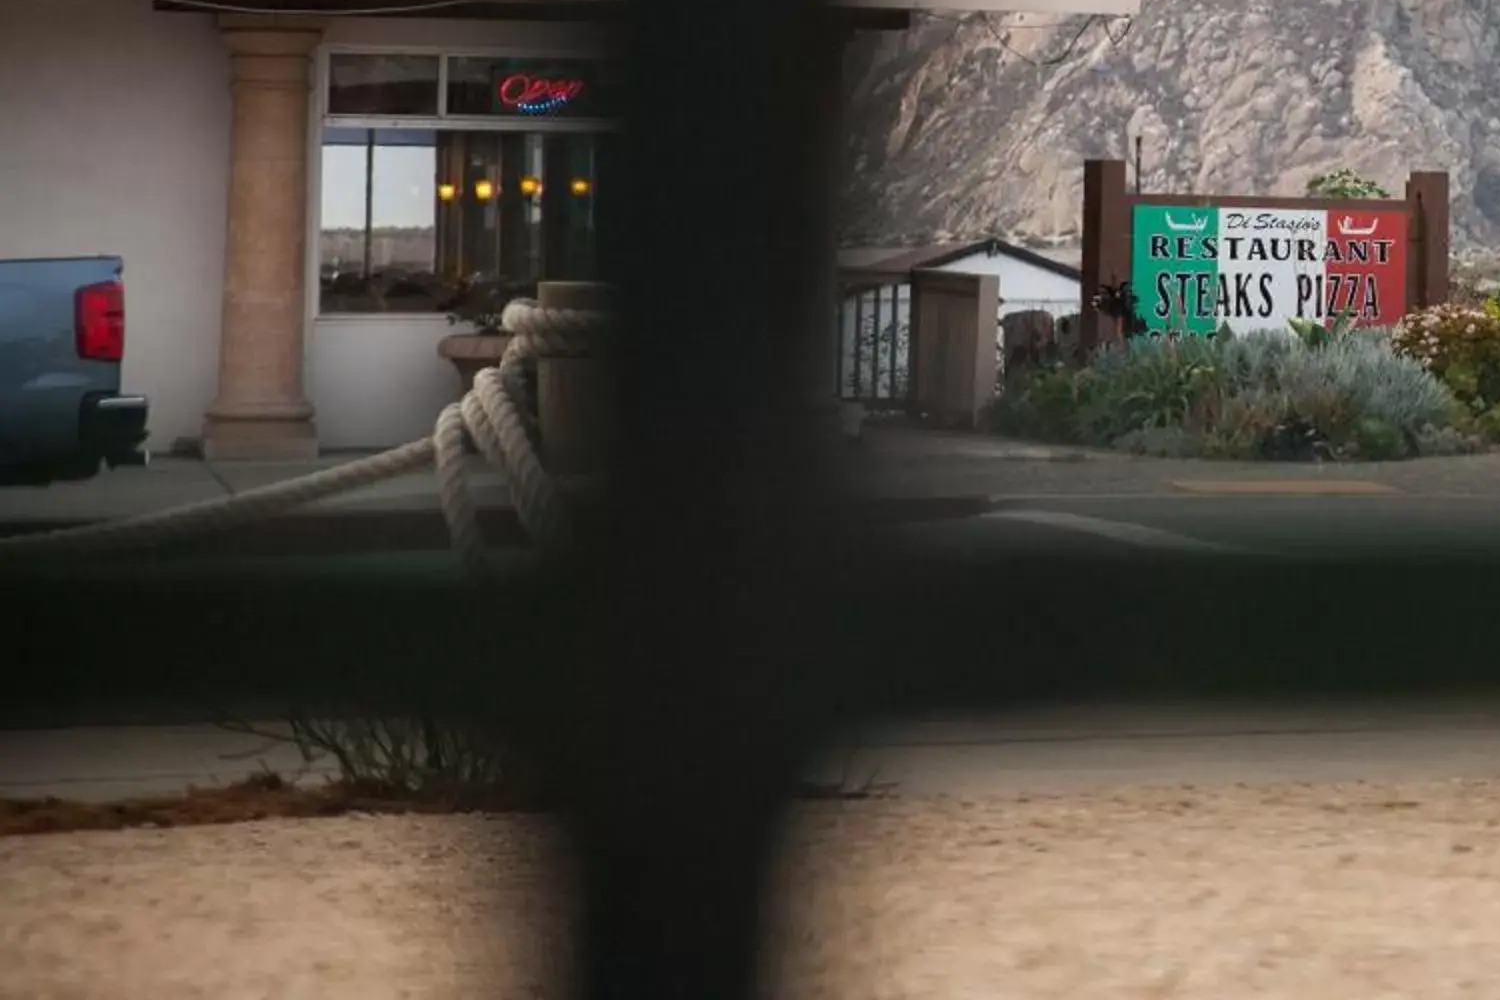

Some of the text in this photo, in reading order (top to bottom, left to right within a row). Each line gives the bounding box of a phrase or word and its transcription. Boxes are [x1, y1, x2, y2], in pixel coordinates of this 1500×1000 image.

[501, 74, 584, 104] Open
[1150, 234, 1394, 263] RESTAURANT
[1155, 271, 1380, 319] STEAKS PIZZA
